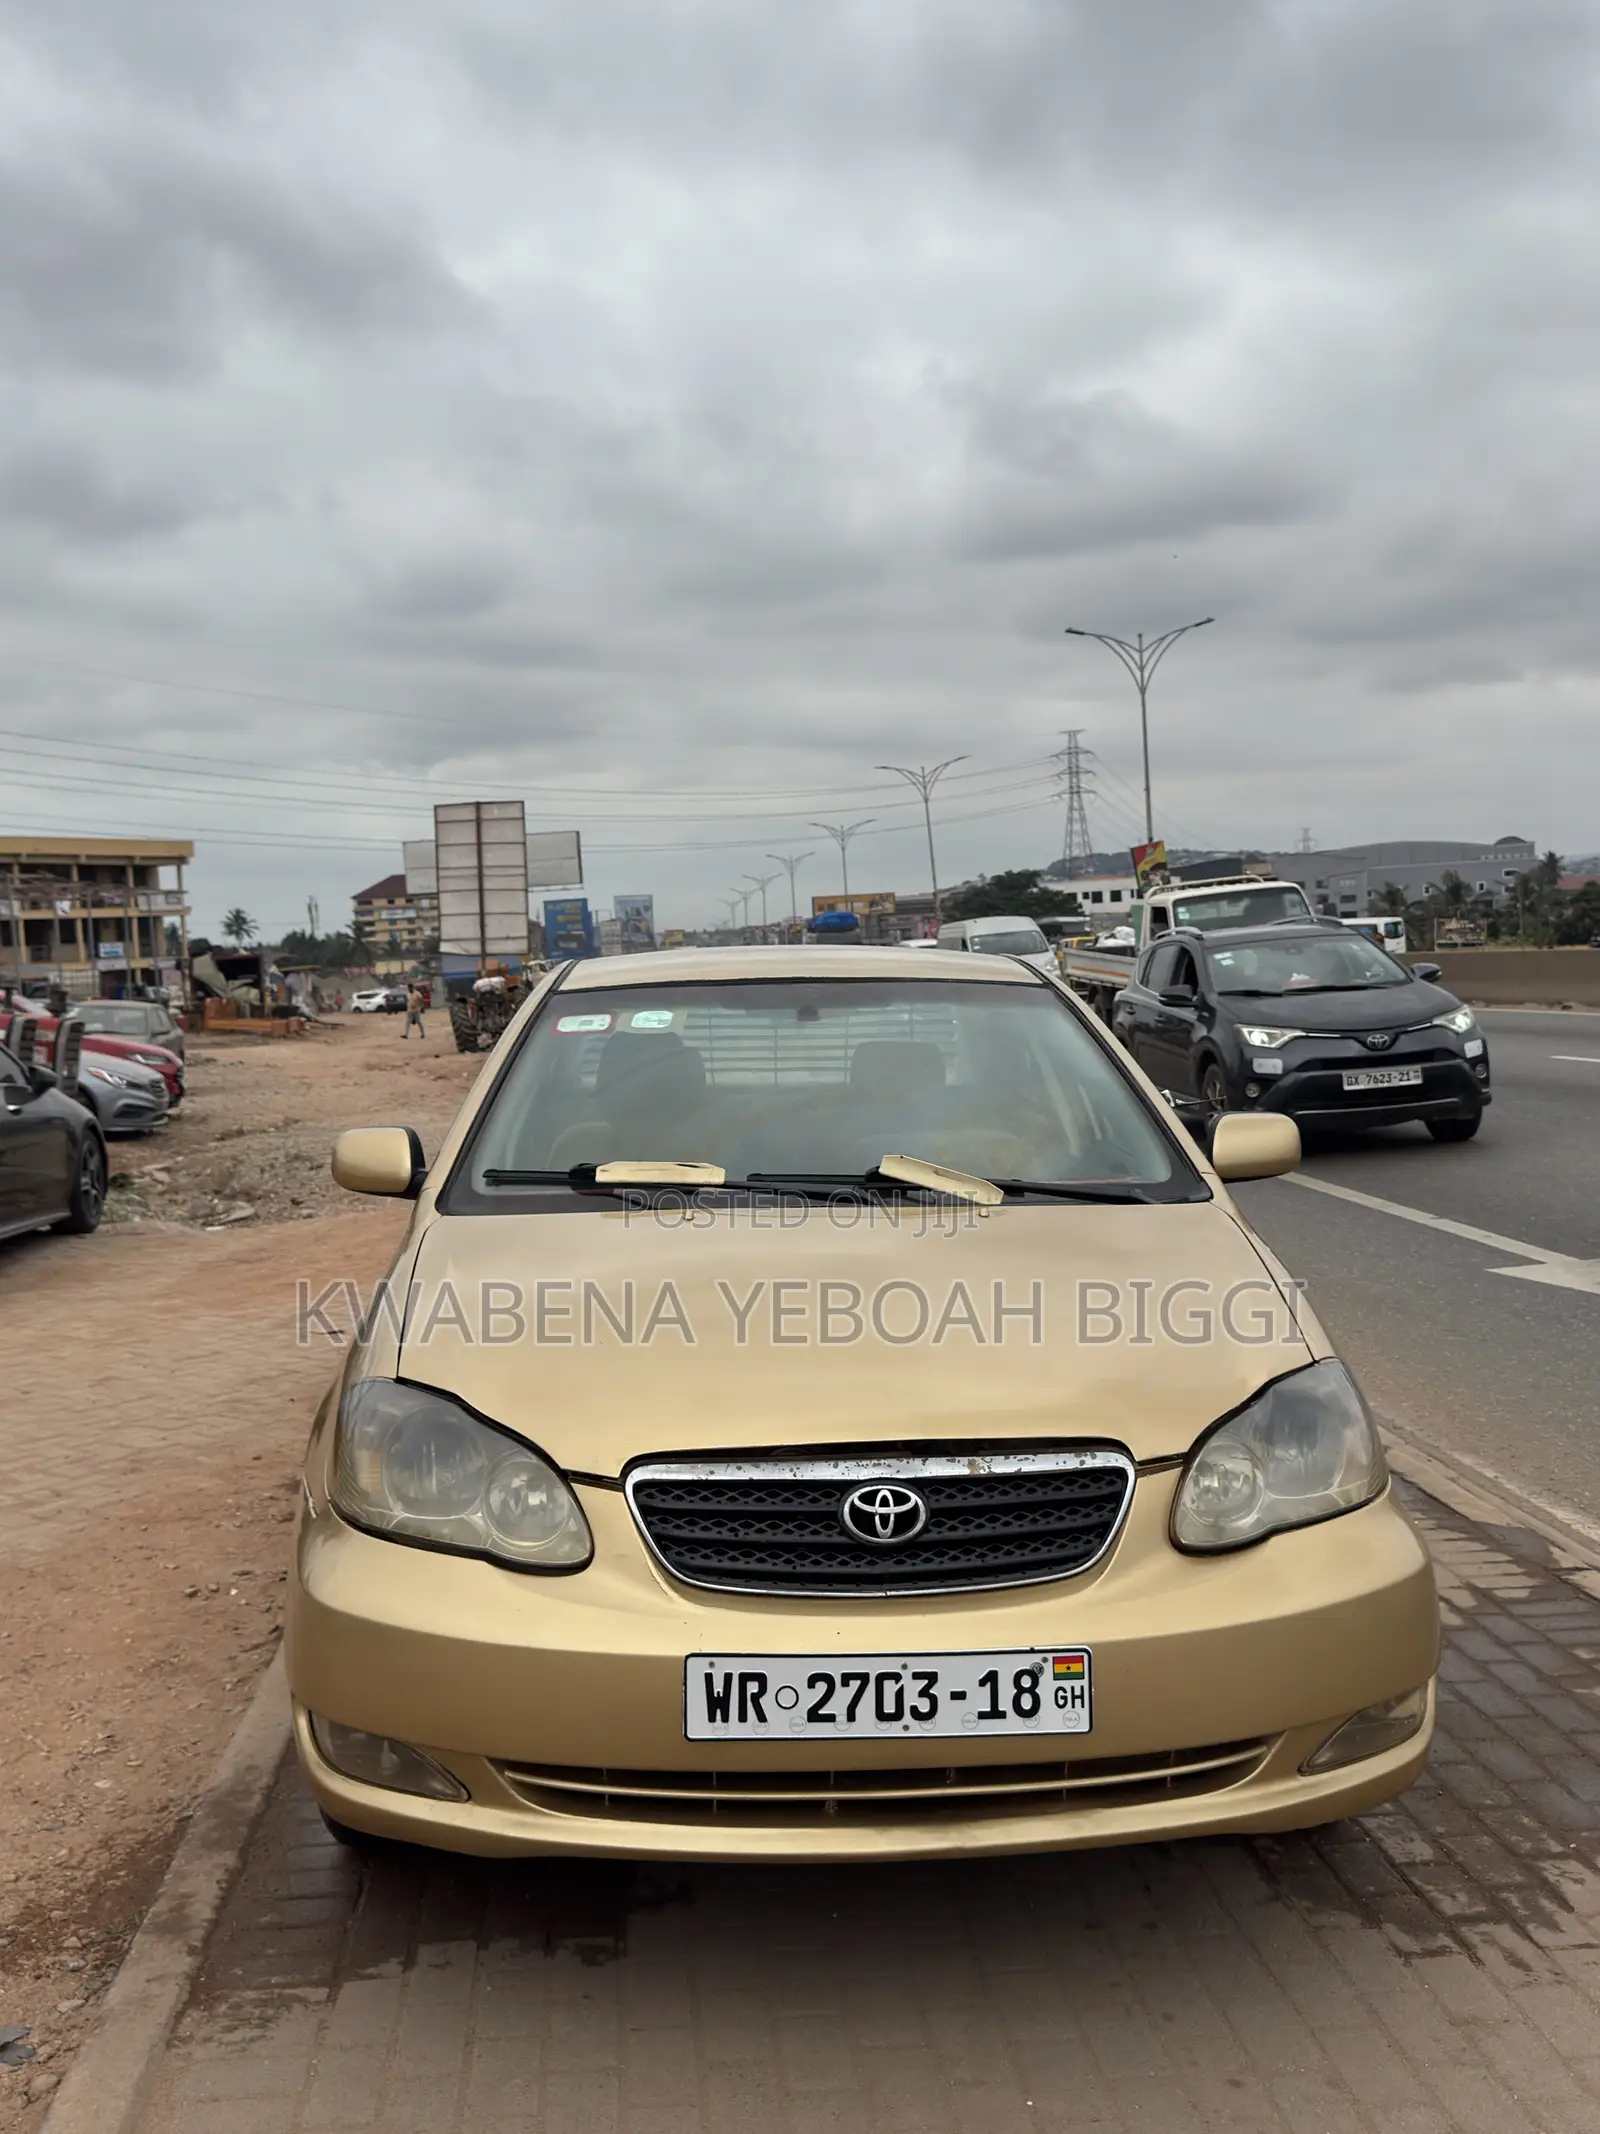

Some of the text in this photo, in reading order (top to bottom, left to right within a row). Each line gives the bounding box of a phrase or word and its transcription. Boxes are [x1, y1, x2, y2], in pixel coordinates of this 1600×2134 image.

[1366, 1070, 1410, 1085] 7623-21
[704, 1668, 1042, 1723] WR 2703-18
[1054, 1685, 1085, 1709] GH
